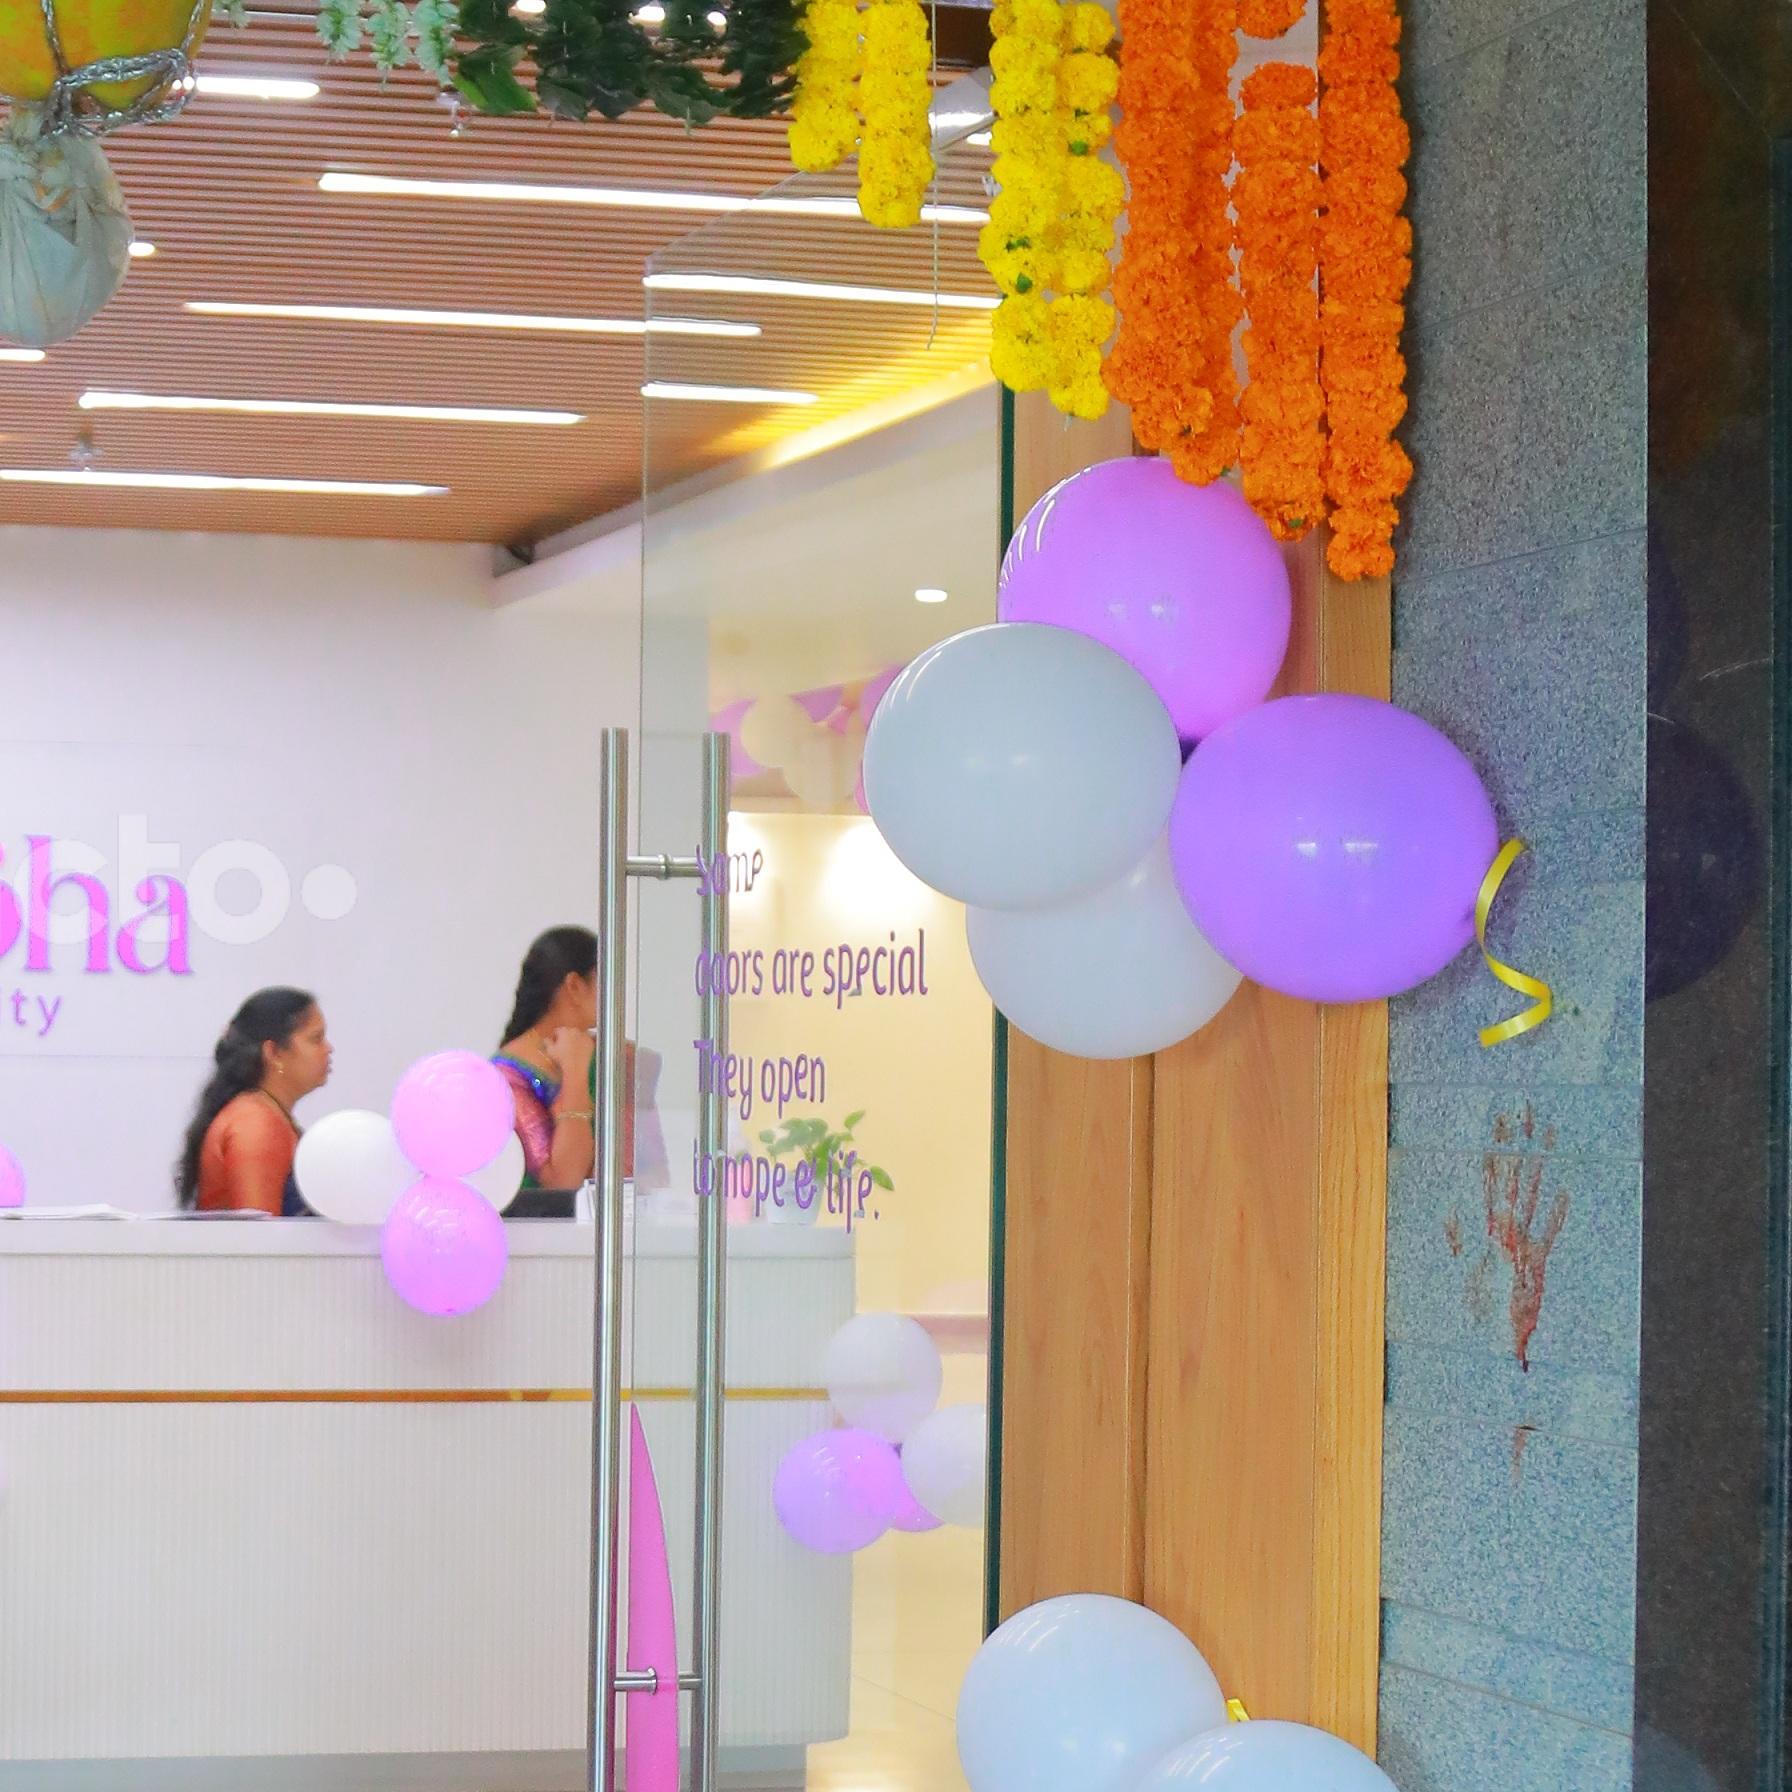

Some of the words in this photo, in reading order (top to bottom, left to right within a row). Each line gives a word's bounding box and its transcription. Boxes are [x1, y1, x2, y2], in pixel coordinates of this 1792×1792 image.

[695, 936, 764, 997] doors
[772, 947, 815, 998] are
[823, 927, 929, 1010] special
[692, 1039, 754, 1121] They
[760, 1053, 825, 1120] open
[693, 1137, 716, 1197] to
